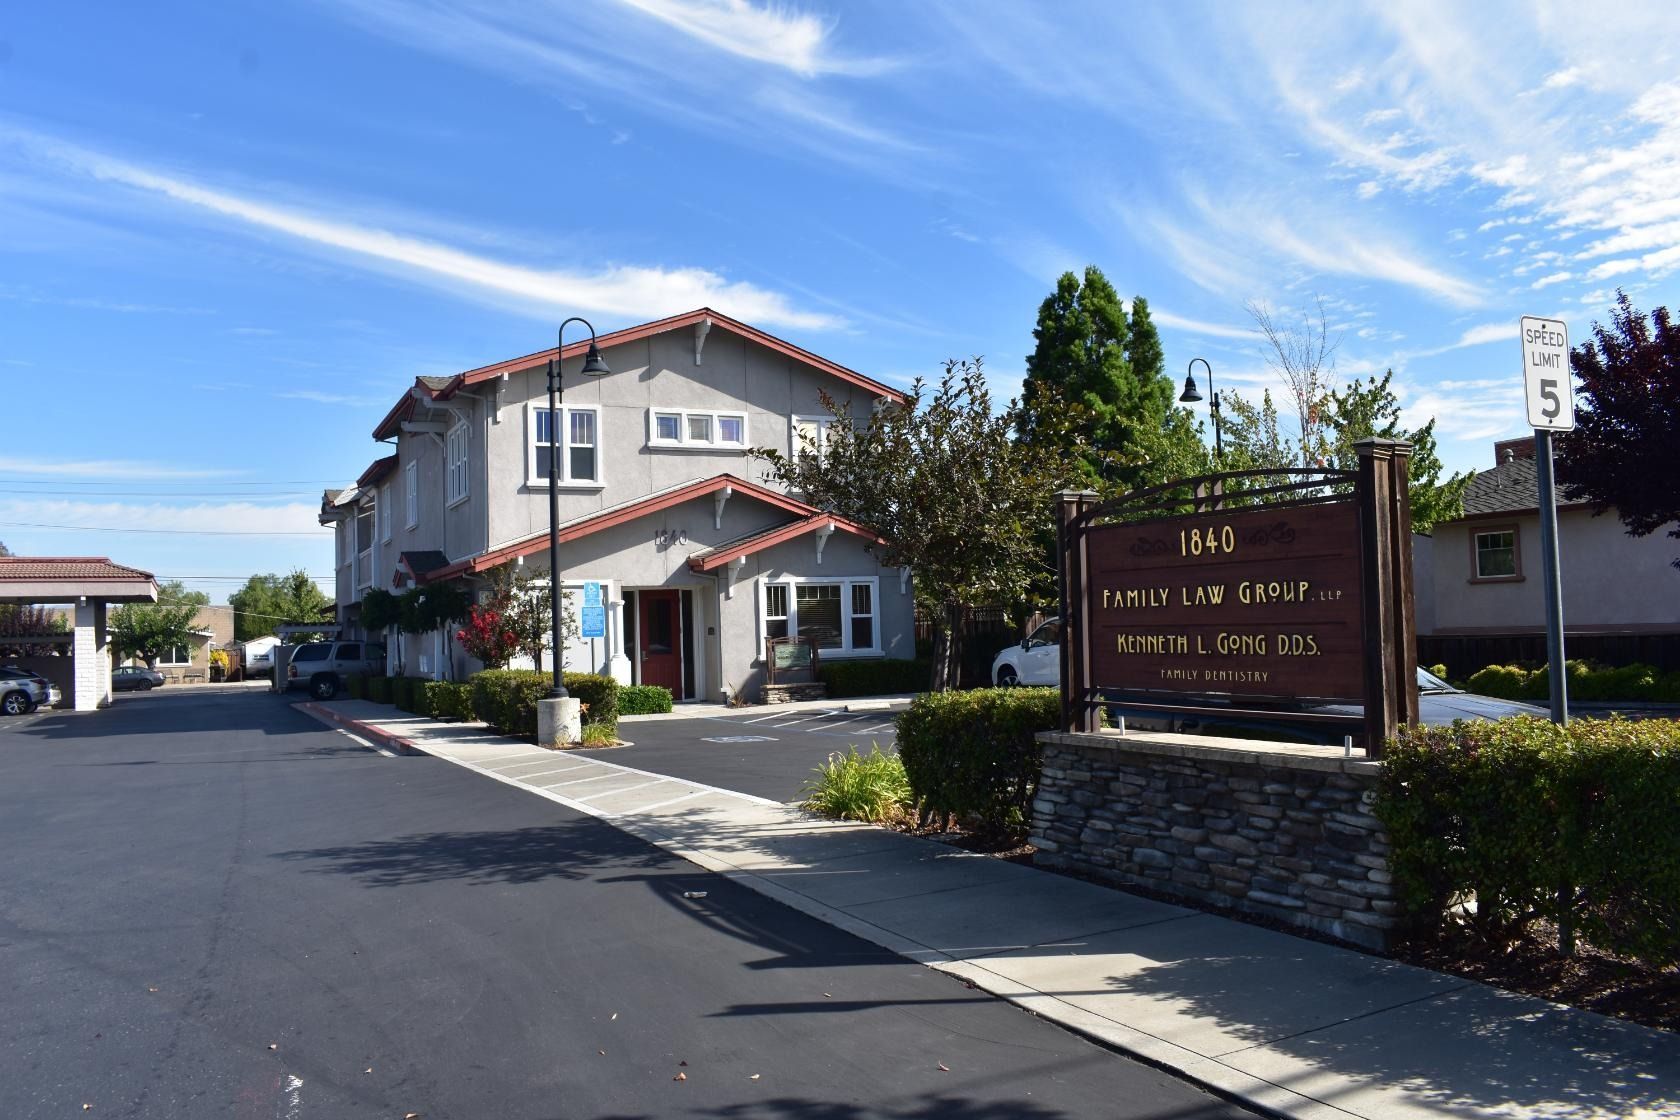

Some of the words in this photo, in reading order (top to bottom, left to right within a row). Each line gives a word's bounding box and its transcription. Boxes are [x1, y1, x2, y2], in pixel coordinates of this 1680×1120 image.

[1526, 328, 1564, 347] SPEED
[1532, 351, 1560, 369] LIMIT
[1540, 378, 1561, 419] 5
[1180, 525, 1236, 557] 1840
[1103, 587, 1169, 609] FAMILY
[1183, 584, 1225, 606] LAW
[1320, 590, 1342, 601] LLP
[1117, 633, 1188, 655] KENNETH
[1198, 634, 1212, 655] L.
[1217, 632, 1266, 656] GONG
[1278, 634, 1321, 656] D.D.S.
[1161, 668, 1198, 681] FAMILY
[1205, 670, 1269, 683] DENTISTRY
